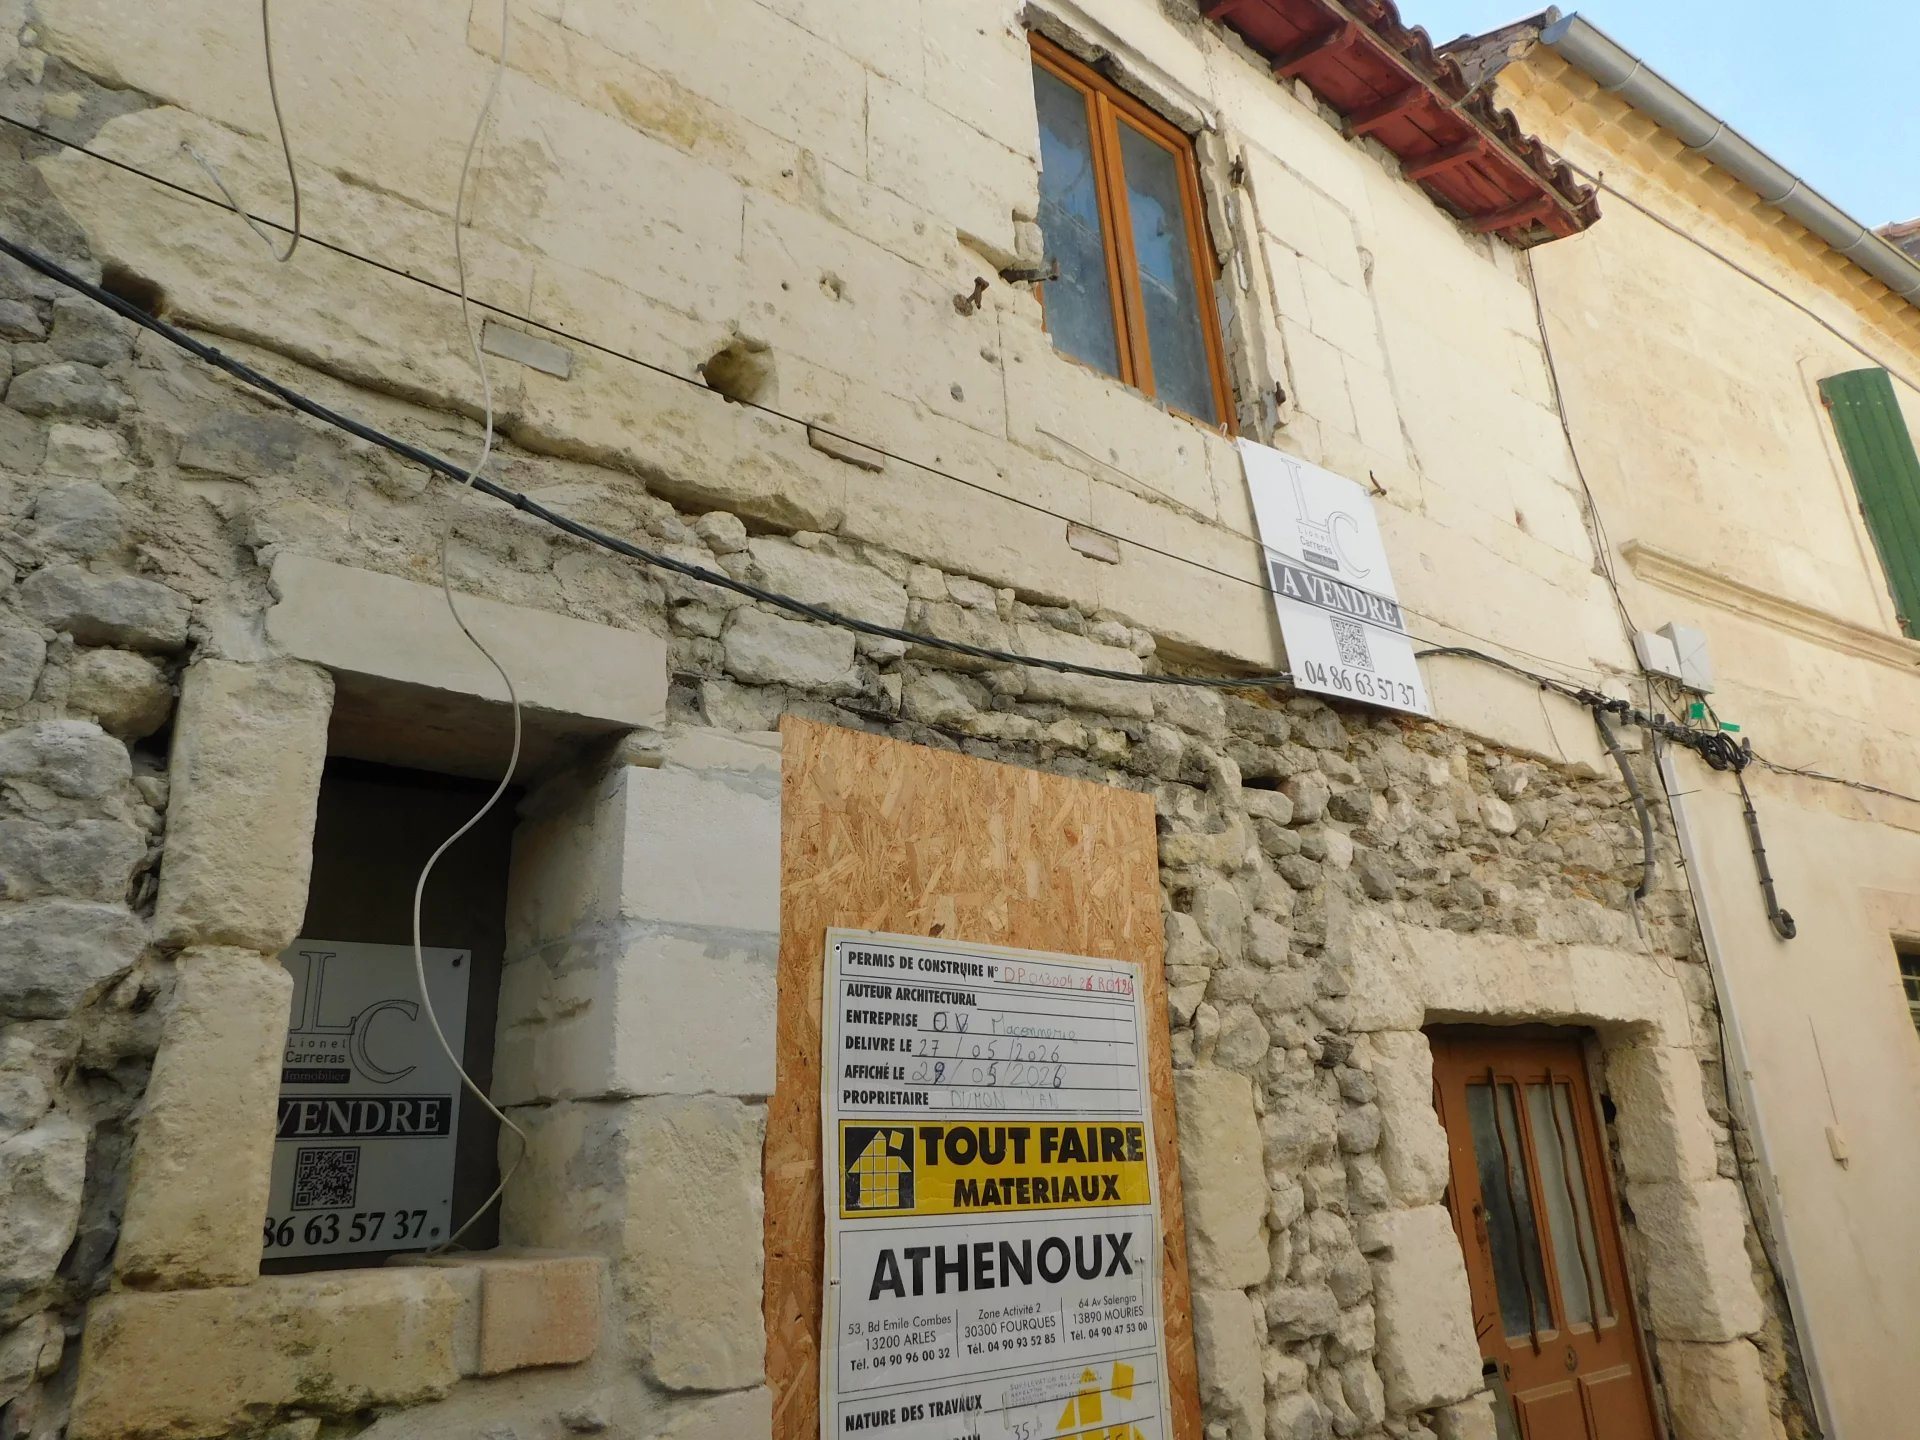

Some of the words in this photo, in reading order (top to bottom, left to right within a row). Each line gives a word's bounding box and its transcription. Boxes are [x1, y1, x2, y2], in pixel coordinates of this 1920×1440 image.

[1283, 567, 1301, 598] A
[1299, 571, 1398, 627] VENDRE
[1304, 660, 1328, 687] 04
[1329, 665, 1351, 692] 86
[1355, 672, 1376, 697] 63
[1377, 677, 1395, 702] 57
[1398, 682, 1416, 707] 37
[848, 951, 895, 968] PERMIS
[899, 956, 914, 970] DE
[917, 958, 984, 978] CONSTRUIRE
[987, 966, 999, 978] N°
[846, 983, 892, 1000] AUTEUR
[895, 987, 977, 1007] ARCHITECTURAL
[846, 1009, 918, 1028] ENTREPRISE
[288, 1037, 346, 1049] Lionel
[845, 1035, 895, 1052] DELIVRE
[899, 1038, 912, 1053] LE
[285, 1050, 345, 1064] Carreras
[844, 1062, 890, 1080] AFFICHÉ
[892, 1066, 905, 1081] LE
[843, 1089, 929, 1106] PROPRIETAIRE
[919, 1126, 1031, 1166] TOUT
[1040, 1127, 1144, 1163] FAIRE
[953, 1174, 1121, 1208] MATERIAUX
[304, 1213, 340, 1246] 63
[349, 1212, 385, 1243] 57
[393, 1210, 428, 1240] 37
[868, 1231, 1134, 1301] ATHENOUX
[978, 1309, 1000, 1320] Zone
[1002, 1304, 1034, 1318] Activité
[1035, 1303, 1042, 1314] 2
[1078, 1297, 1090, 1309] 64
[1091, 1296, 1102, 1308] Av
[1103, 1294, 1137, 1307] Salengro
[847, 1322, 865, 1336] 53,
[868, 1320, 881, 1333] Bd
[883, 1317, 910, 1332] Emile
[912, 1313, 952, 1328] Combes
[1072, 1309, 1102, 1325] 13890
[1104, 1305, 1144, 1322] MOURIES
[964, 1323, 998, 1339] 30300
[1000, 1315, 1056, 1334] FOURQUES
[1070, 1331, 1086, 1342] Tél.
[1088, 1327, 1099, 1339] 04
[1101, 1326, 1112, 1337] 90
[1114, 1324, 1124, 1335] 47
[1126, 1322, 1136, 1334] 53
[1138, 1321, 1148, 1332] 00
[866, 1334, 901, 1352] 13200
[903, 1330, 937, 1347] ARLES
[967, 1344, 985, 1355] Tél.
[987, 1341, 1000, 1353] 04
[1002, 1338, 1014, 1350] 90
[1016, 1336, 1028, 1348] 93
[1030, 1334, 1042, 1346] 52
[1044, 1333, 1056, 1345] 85
[850, 1359, 869, 1371] Tél.
[872, 1356, 887, 1368] 04
[889, 1354, 903, 1366] 90
[905, 1352, 919, 1364] 96
[922, 1349, 935, 1361] 00
[938, 1347, 951, 1359] 32
[846, 1408, 896, 1432] NATURE
[901, 1404, 925, 1423] DES
[929, 1394, 982, 1418] TRAVAUX
